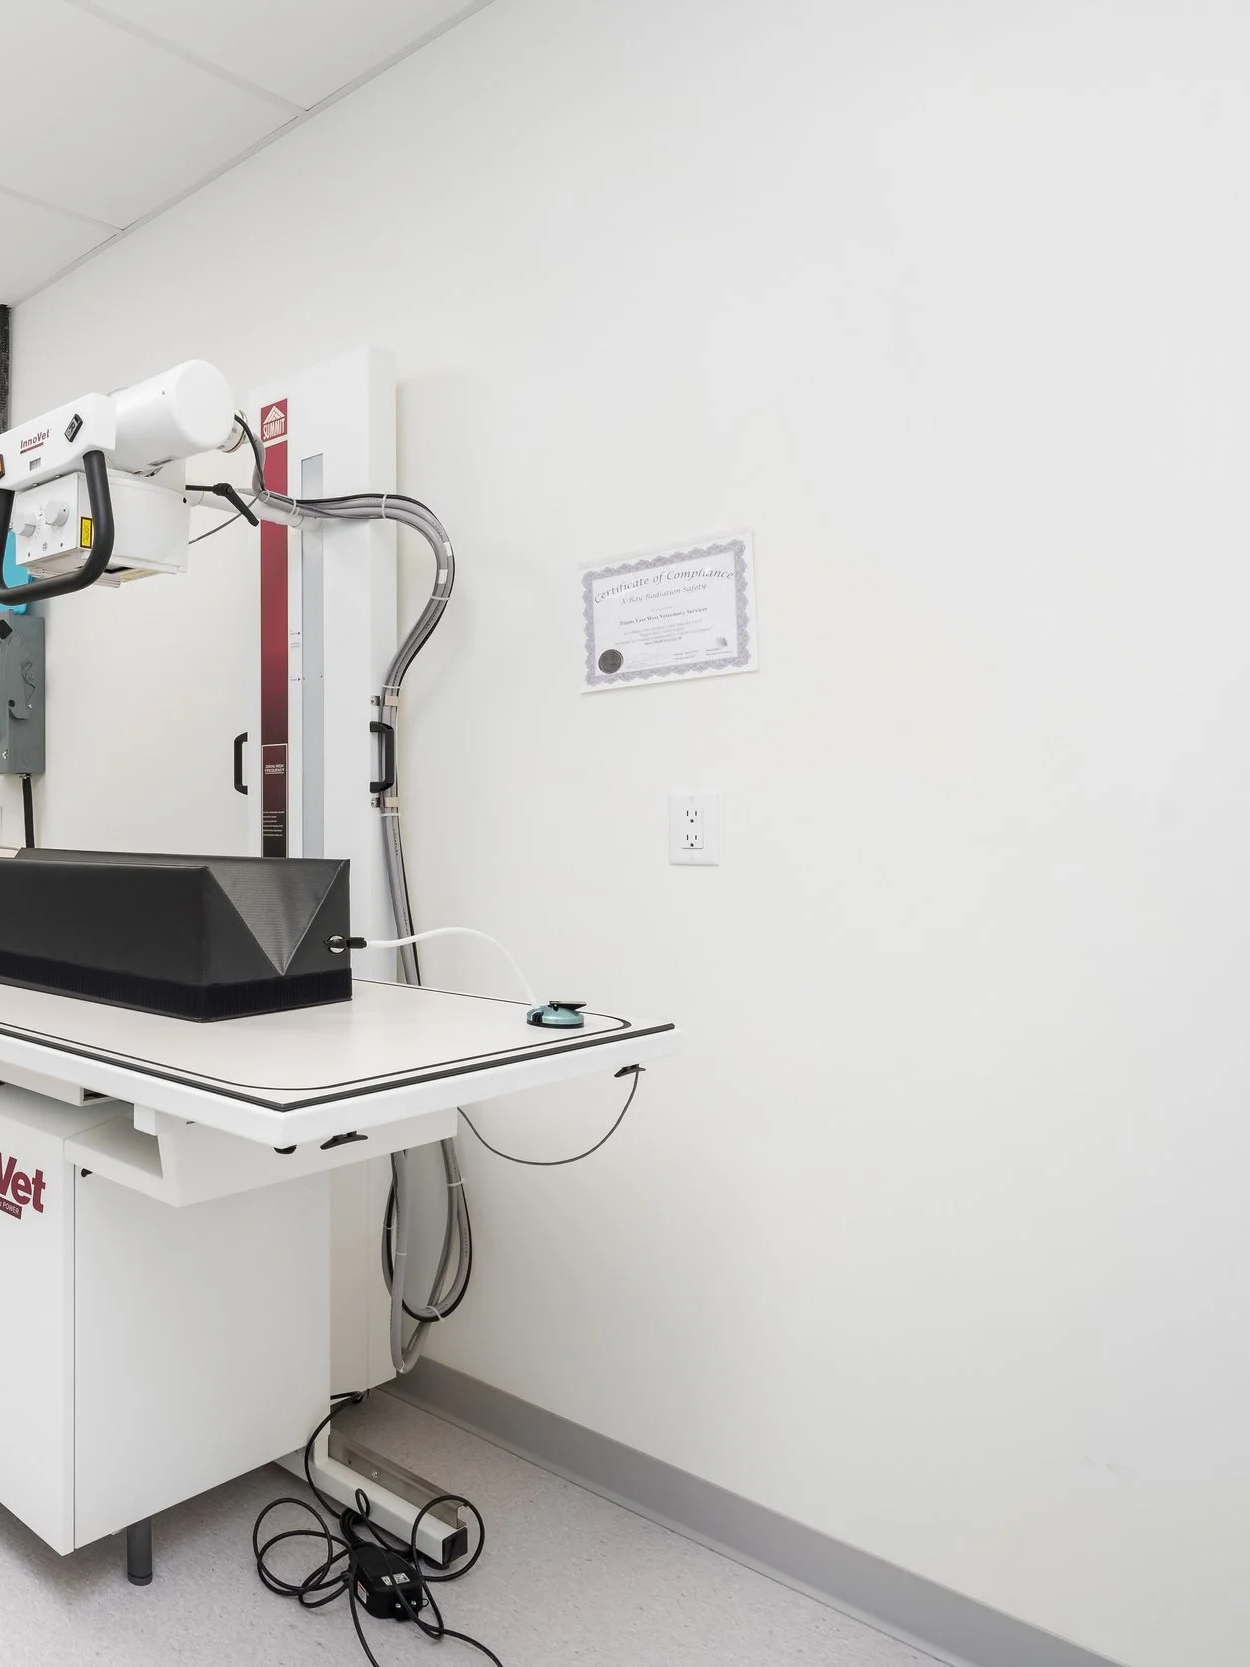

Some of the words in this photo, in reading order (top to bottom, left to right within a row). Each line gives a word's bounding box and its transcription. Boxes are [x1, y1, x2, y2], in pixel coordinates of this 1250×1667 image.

[20, 429, 50, 449] InnoVet
[263, 418, 285, 440] SUMMIT
[594, 577, 649, 604] Certificate
[653, 570, 665, 586] of
[666, 567, 734, 581] Compliance
[682, 582, 707, 594] Safety
[2, 1201, 20, 1214] POWER
